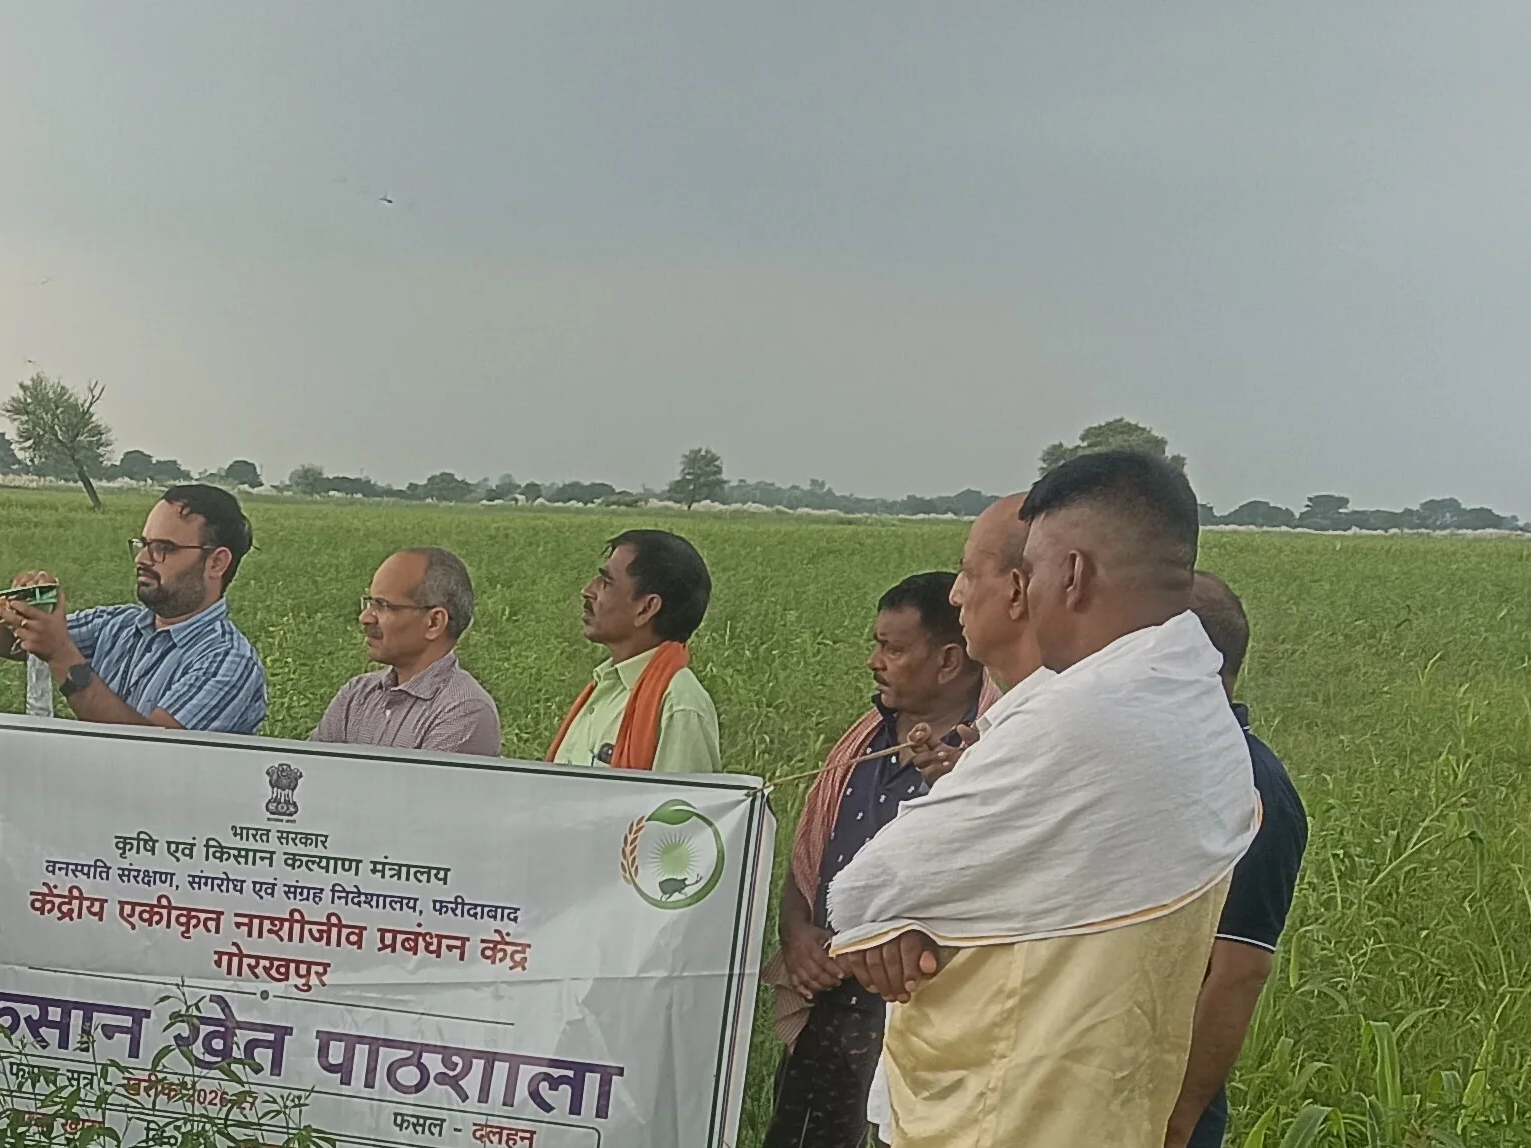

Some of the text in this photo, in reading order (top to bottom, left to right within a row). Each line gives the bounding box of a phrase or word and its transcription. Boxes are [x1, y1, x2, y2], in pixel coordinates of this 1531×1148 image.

[114, 831, 451, 885] कृषि एवं किसान कल्याण मंत्रालय
[231, 825, 329, 849] भारत सरकार
[45, 859, 112, 881] वनस्पति
[118, 863, 180, 890] संरक्षण,
[187, 870, 246, 894] संगरोध
[252, 878, 277, 900] एवं
[283, 880, 325, 905] संग्रह
[432, 895, 520, 924] फरीदाबाद
[29, 882, 532, 971] केंद्रीय एकीकृत नाशीजीव प्रबंधन केंद्र
[213, 941, 331, 992] गोरखपुर
[170, 994, 294, 1077] खेत
[315, 1029, 625, 1120] पाठशाला
[393, 1111, 447, 1137] फसल
[472, 1122, 537, 1148] दलहन
